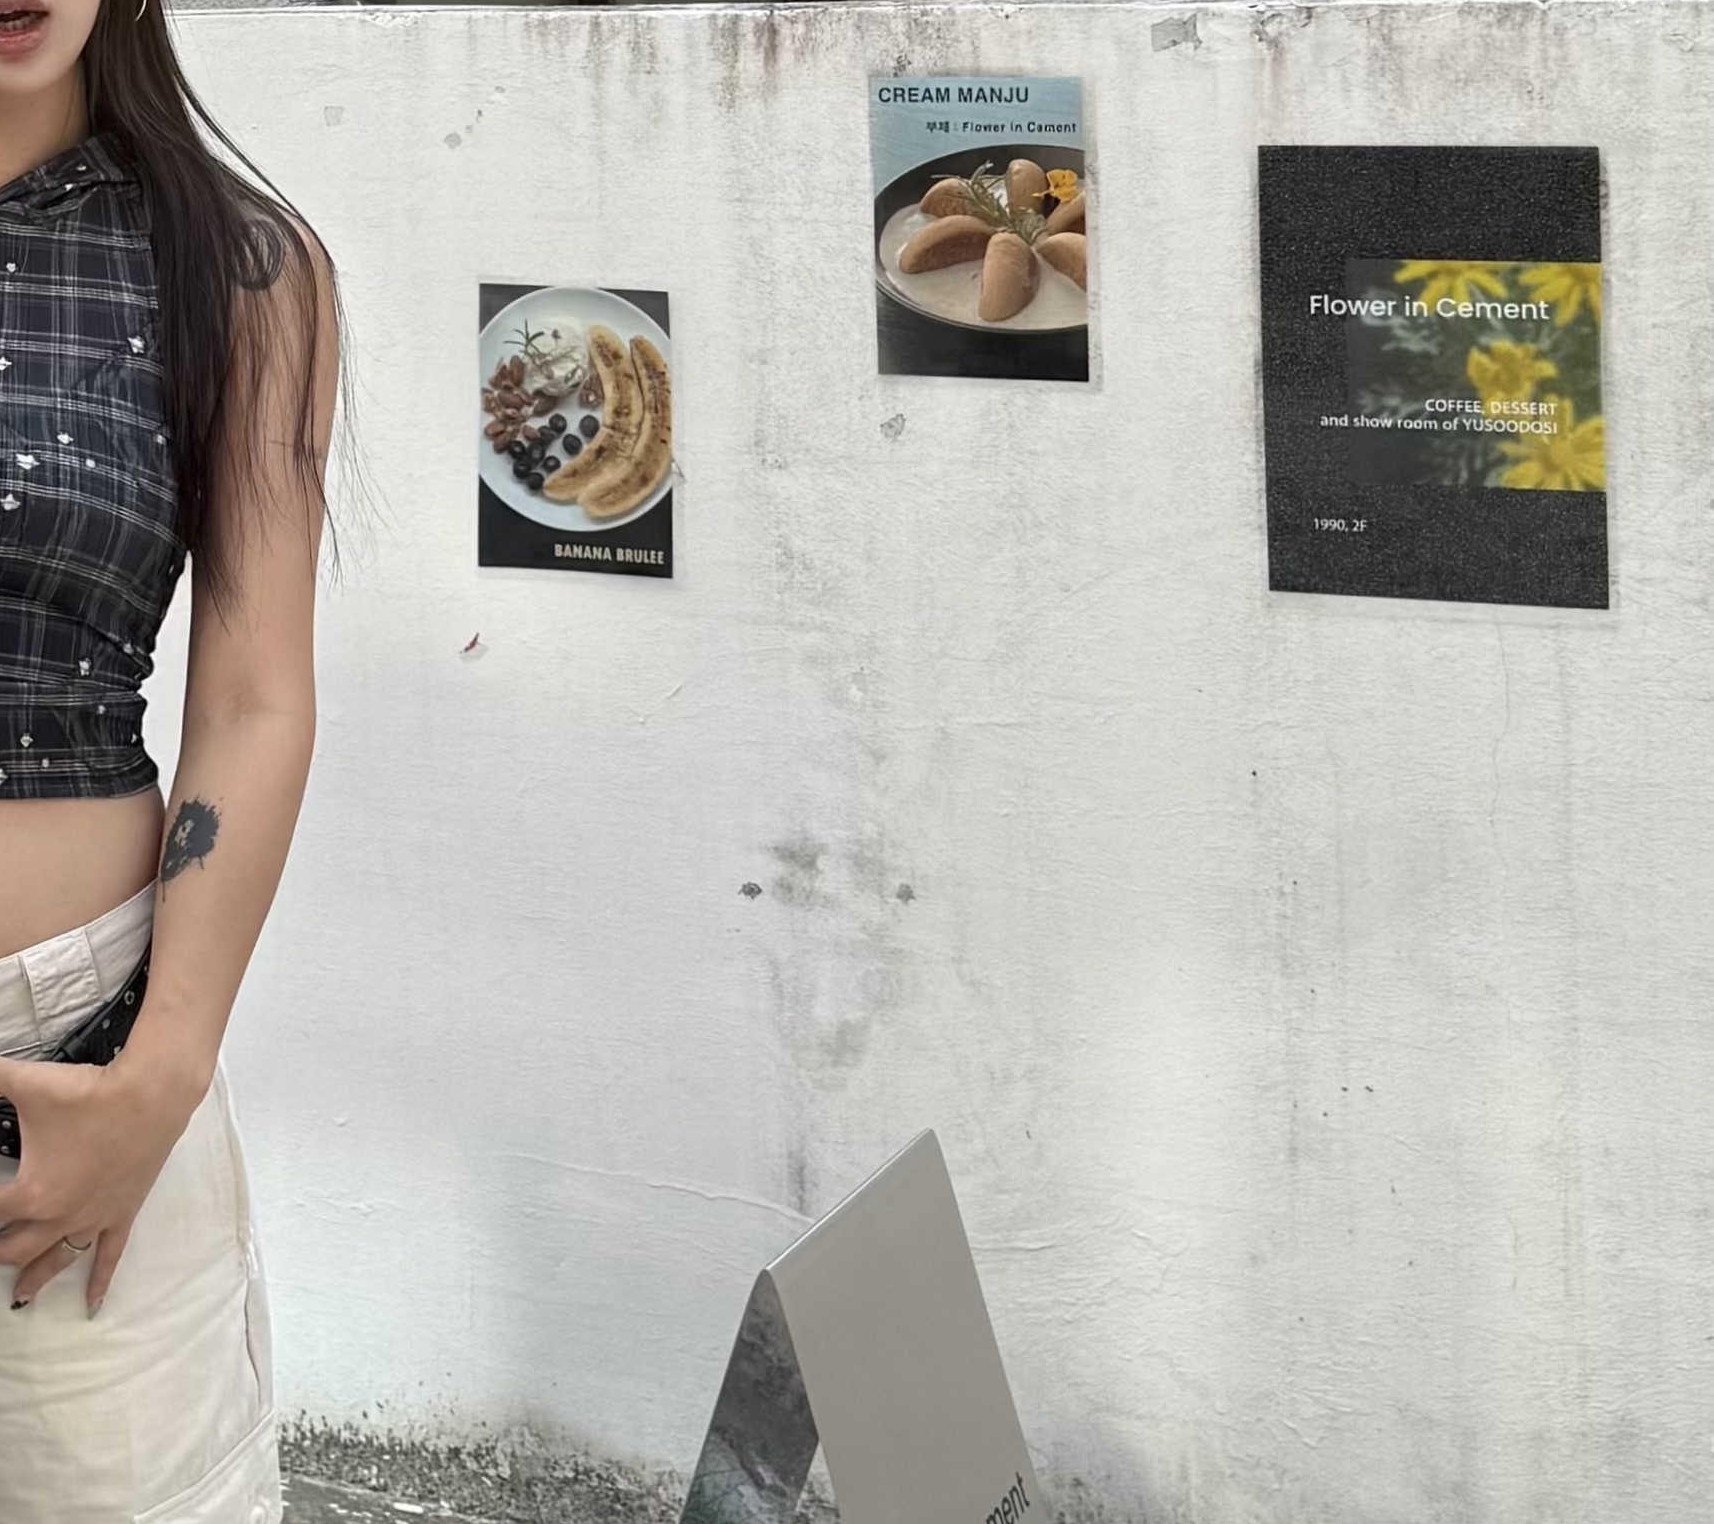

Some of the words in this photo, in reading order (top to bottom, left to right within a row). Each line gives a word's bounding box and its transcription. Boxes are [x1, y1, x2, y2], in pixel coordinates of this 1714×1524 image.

[878, 87, 951, 103] CREAM
[957, 87, 1029, 103] MANJU
[962, 122, 1005, 133] Flower
[1010, 122, 1023, 133] in
[1027, 122, 1077, 133] Cement
[1309, 294, 1396, 316] Flower
[1404, 295, 1428, 317] in
[1436, 297, 1549, 320] Cement
[1425, 399, 1485, 414] COFFEE,
[1490, 401, 1558, 415] DESSERT
[1320, 414, 1349, 427] and
[1353, 414, 1393, 428] show
[1397, 418, 1438, 430] room
[1442, 418, 1459, 430] of
[1462, 419, 1558, 434] YUSOODOSI
[1352, 519, 1367, 532] 2F
[554, 543, 612, 561] BANANA
[616, 548, 665, 565] BRULEE
